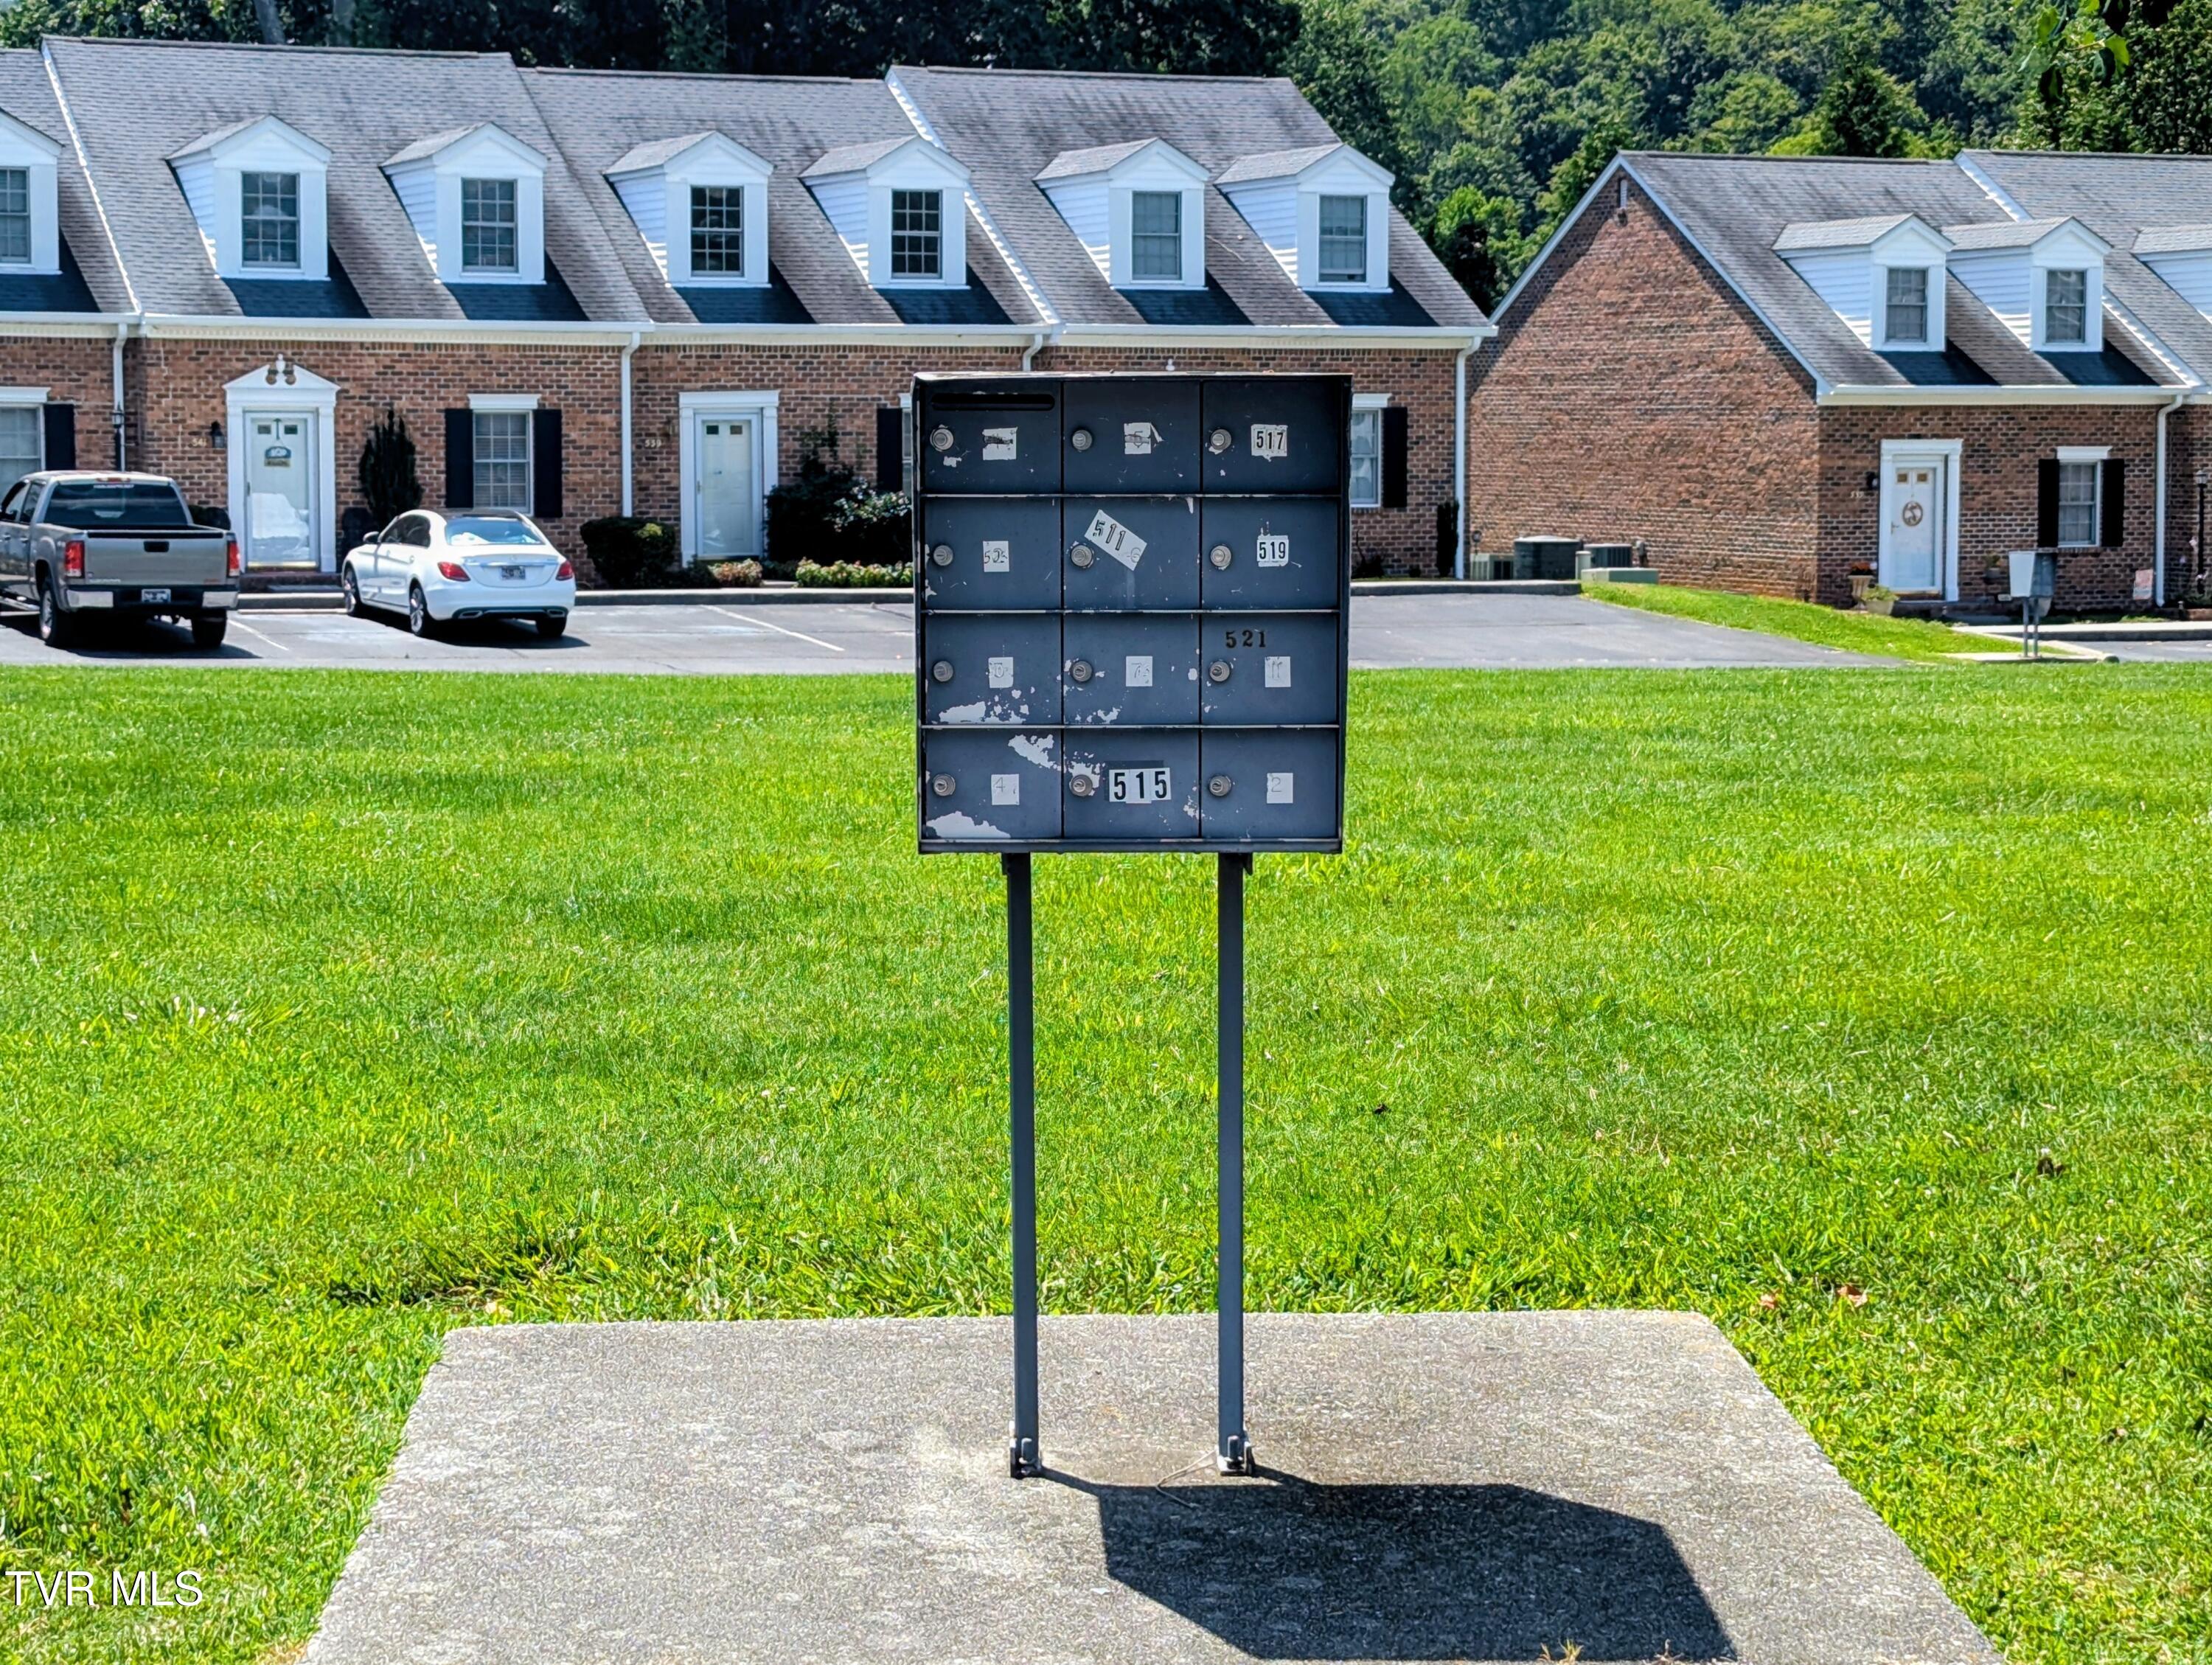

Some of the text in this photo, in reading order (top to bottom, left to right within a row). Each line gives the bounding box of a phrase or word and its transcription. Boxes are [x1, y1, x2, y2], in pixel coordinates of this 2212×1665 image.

[1256, 431, 1284, 449] 517
[1093, 520, 1126, 551] 511
[1259, 541, 1286, 559] 519
[1225, 630, 1266, 648] 521
[1114, 771, 1167, 800] 515
[1271, 776, 1283, 793] 2
